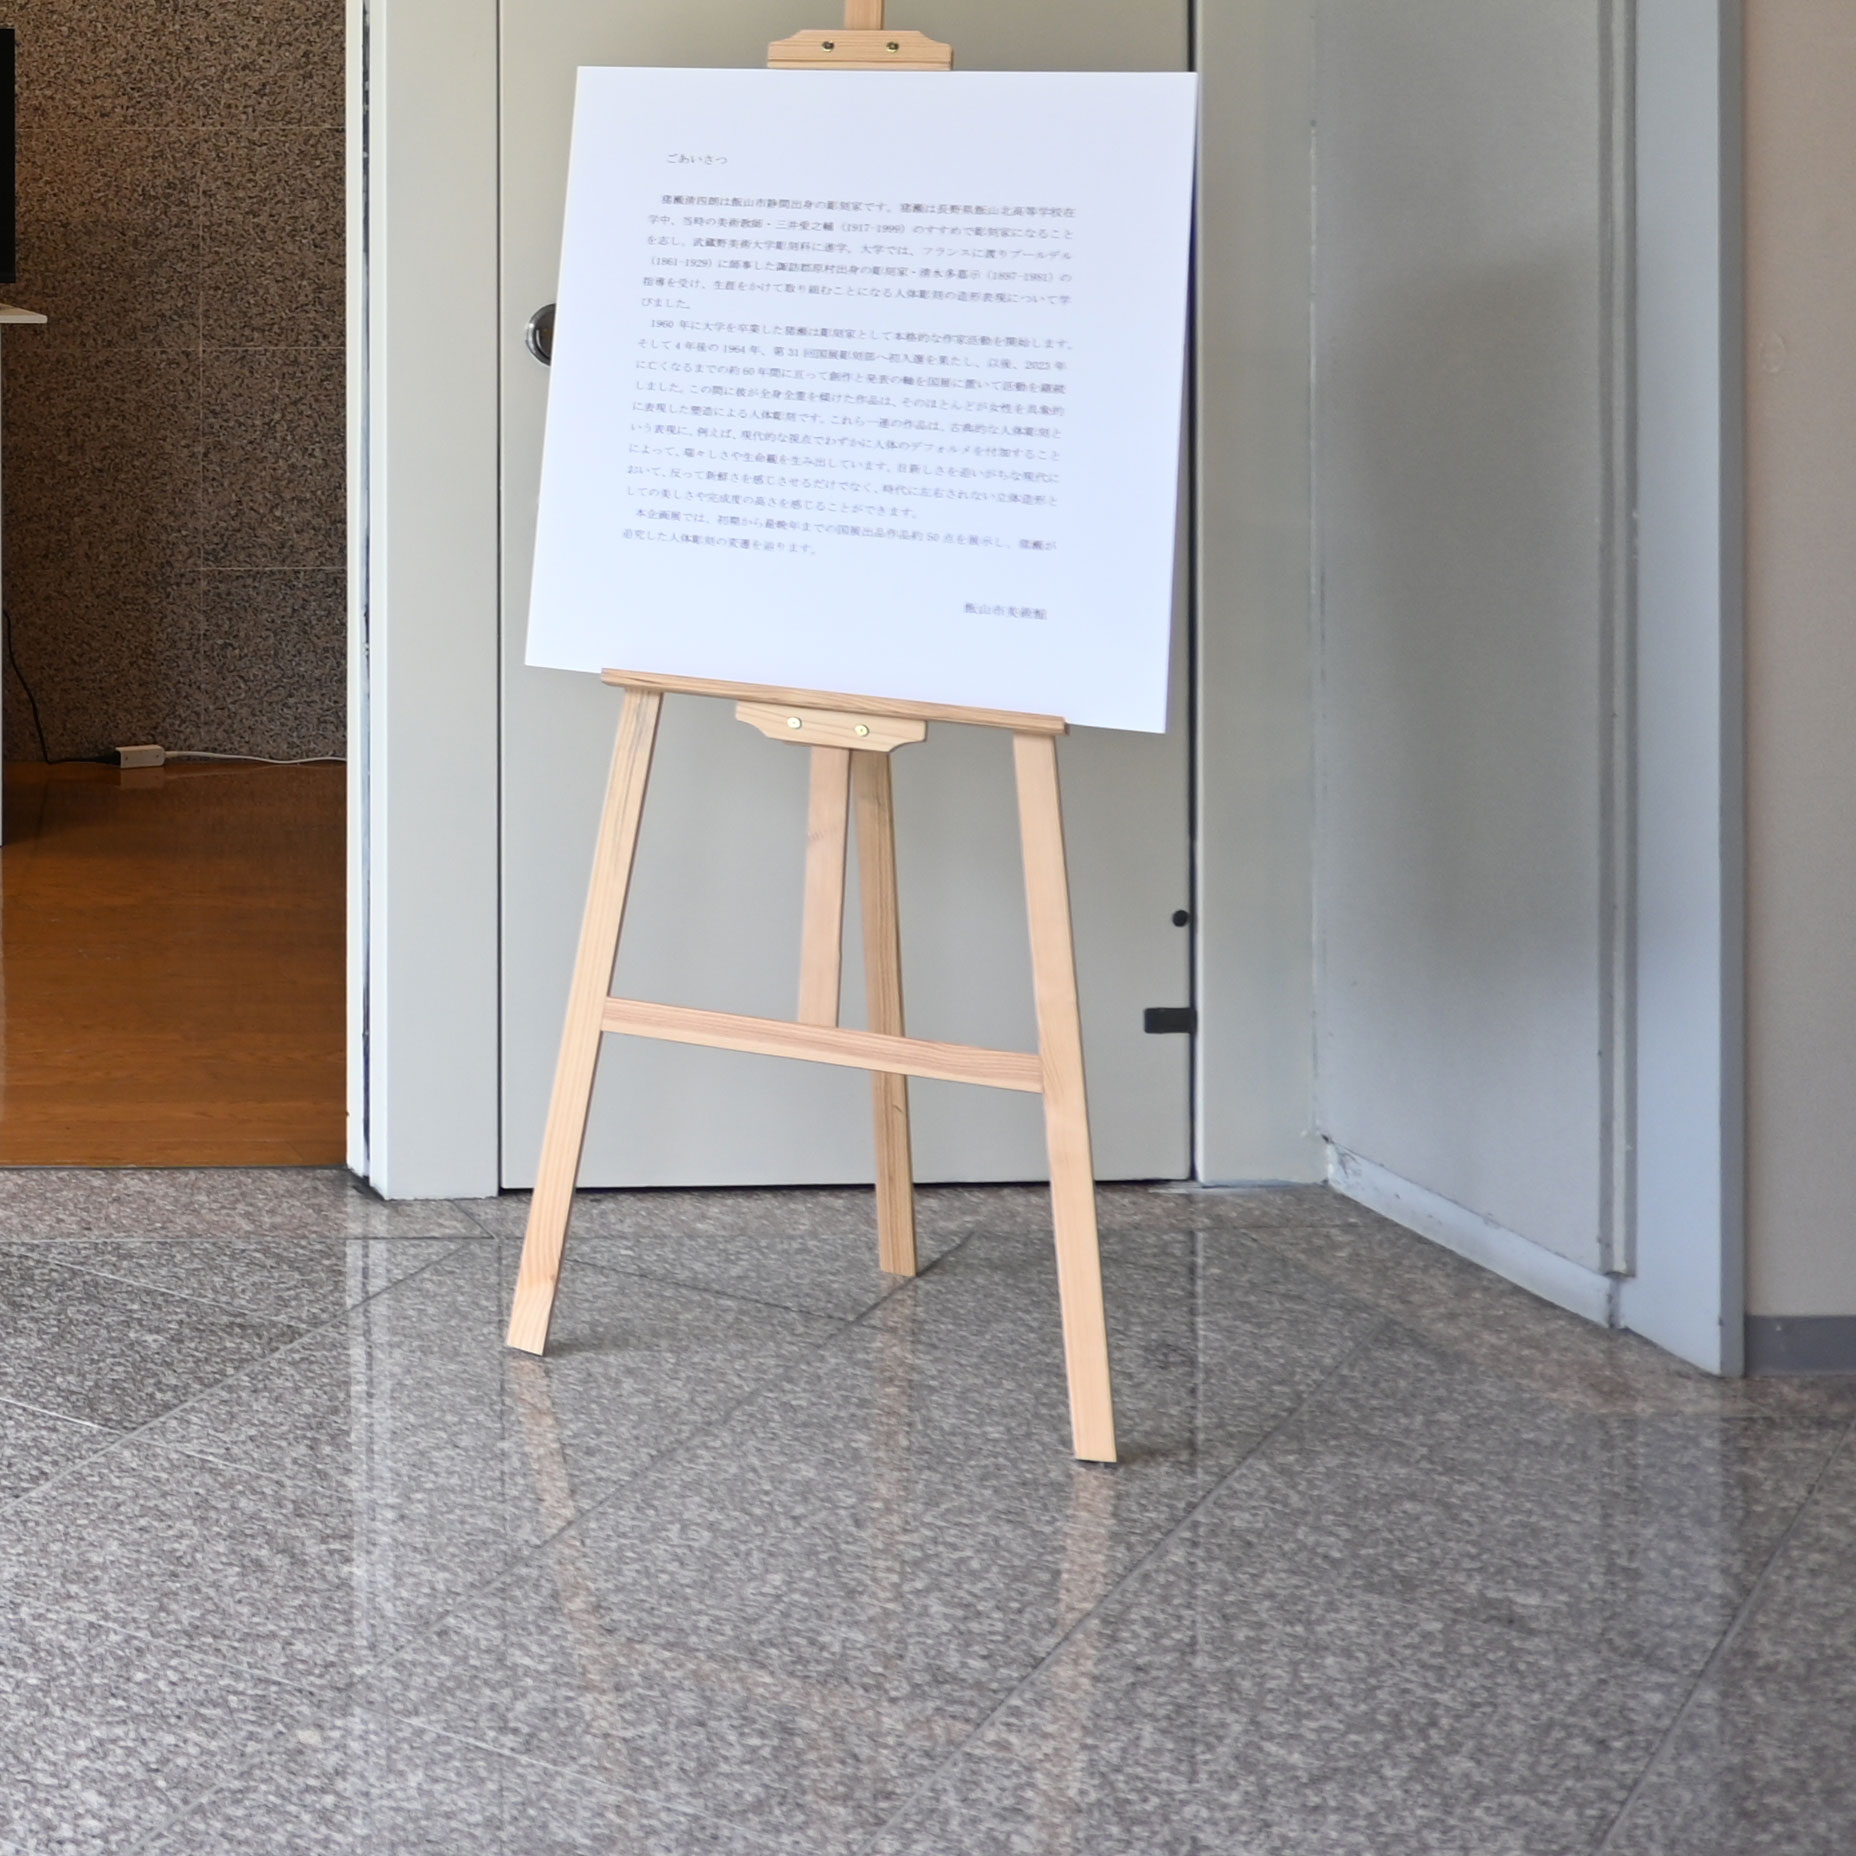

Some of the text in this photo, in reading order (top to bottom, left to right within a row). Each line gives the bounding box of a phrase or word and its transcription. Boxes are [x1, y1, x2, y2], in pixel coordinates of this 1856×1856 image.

[666, 152, 728, 166] ごあいさつ
